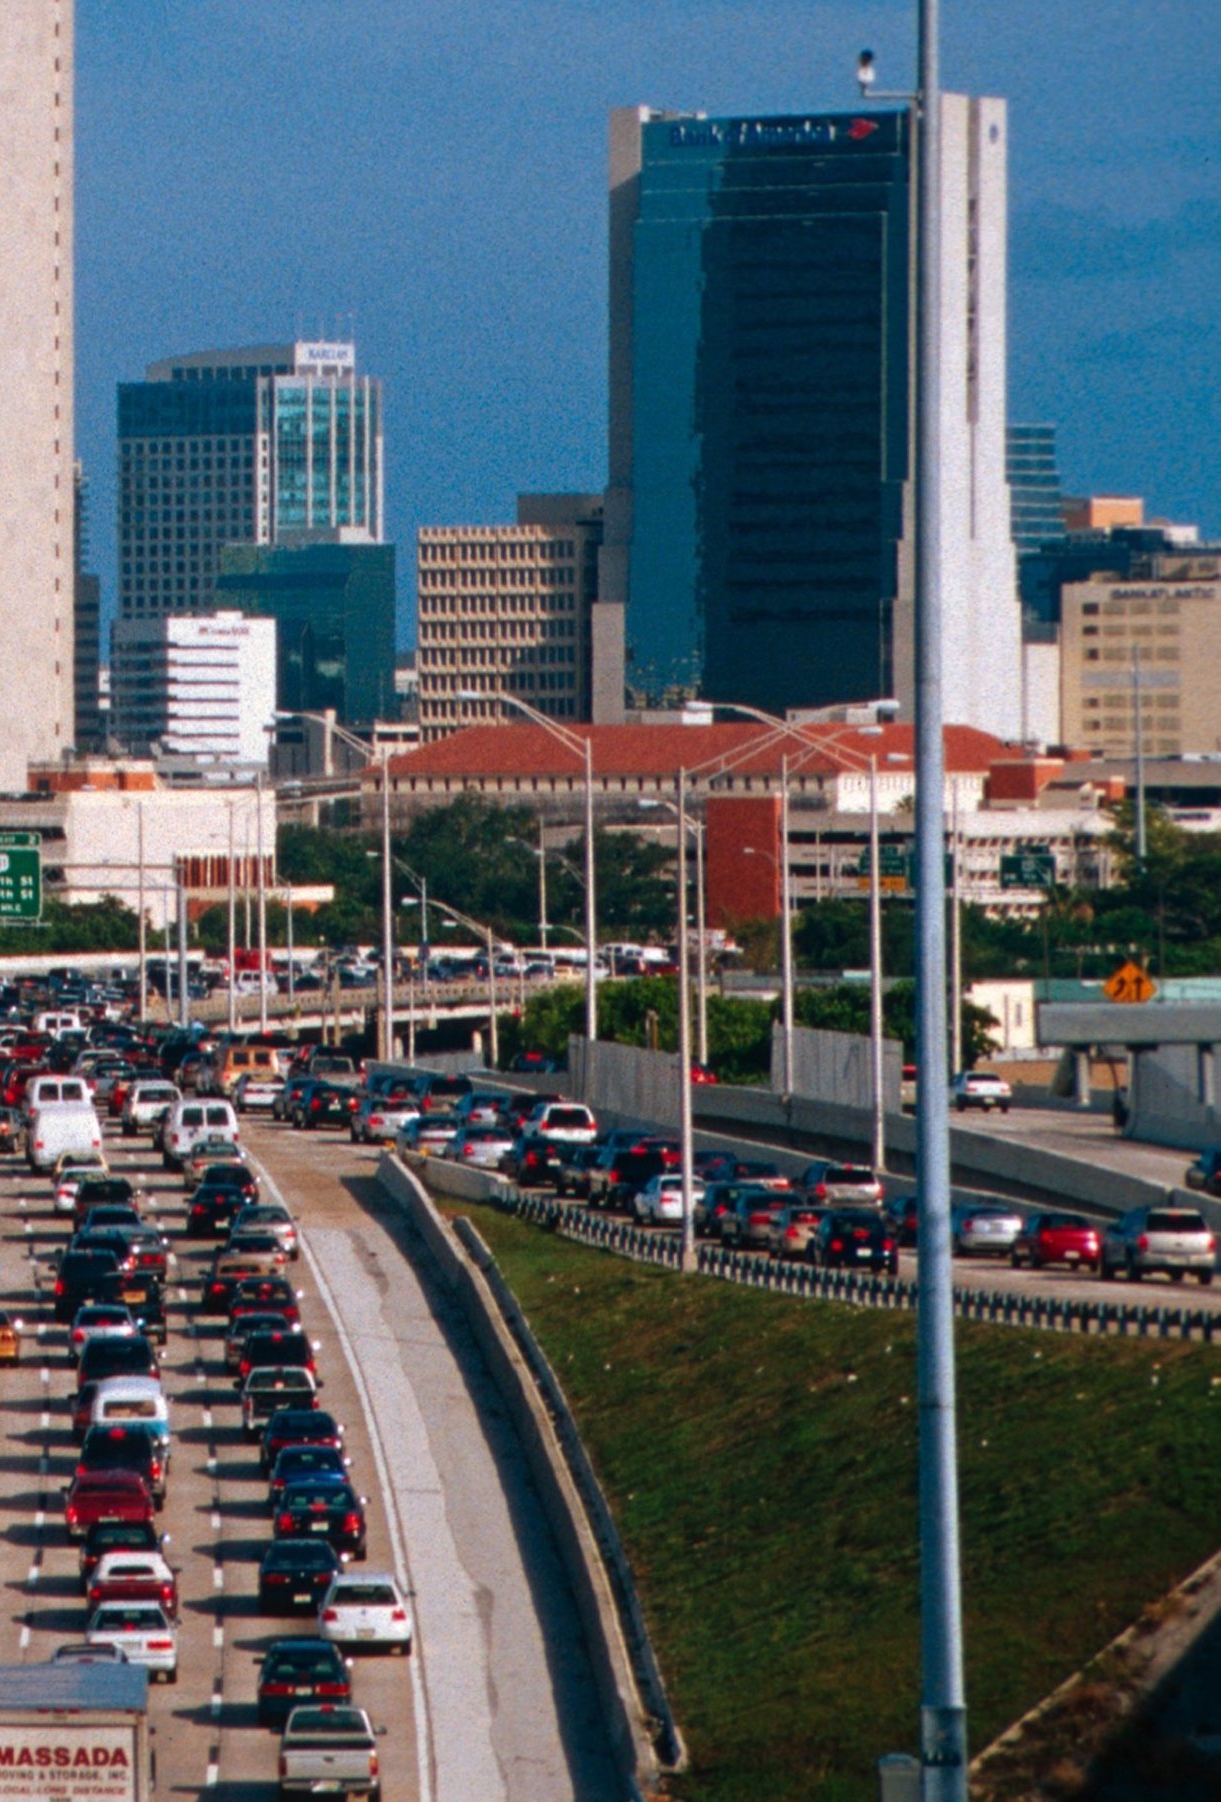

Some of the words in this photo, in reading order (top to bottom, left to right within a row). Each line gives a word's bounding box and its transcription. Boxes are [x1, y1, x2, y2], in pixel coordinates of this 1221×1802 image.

[20, 876, 33, 886] St
[20, 888, 33, 899] St
[72, 1786, 126, 1795] DISTANCE
